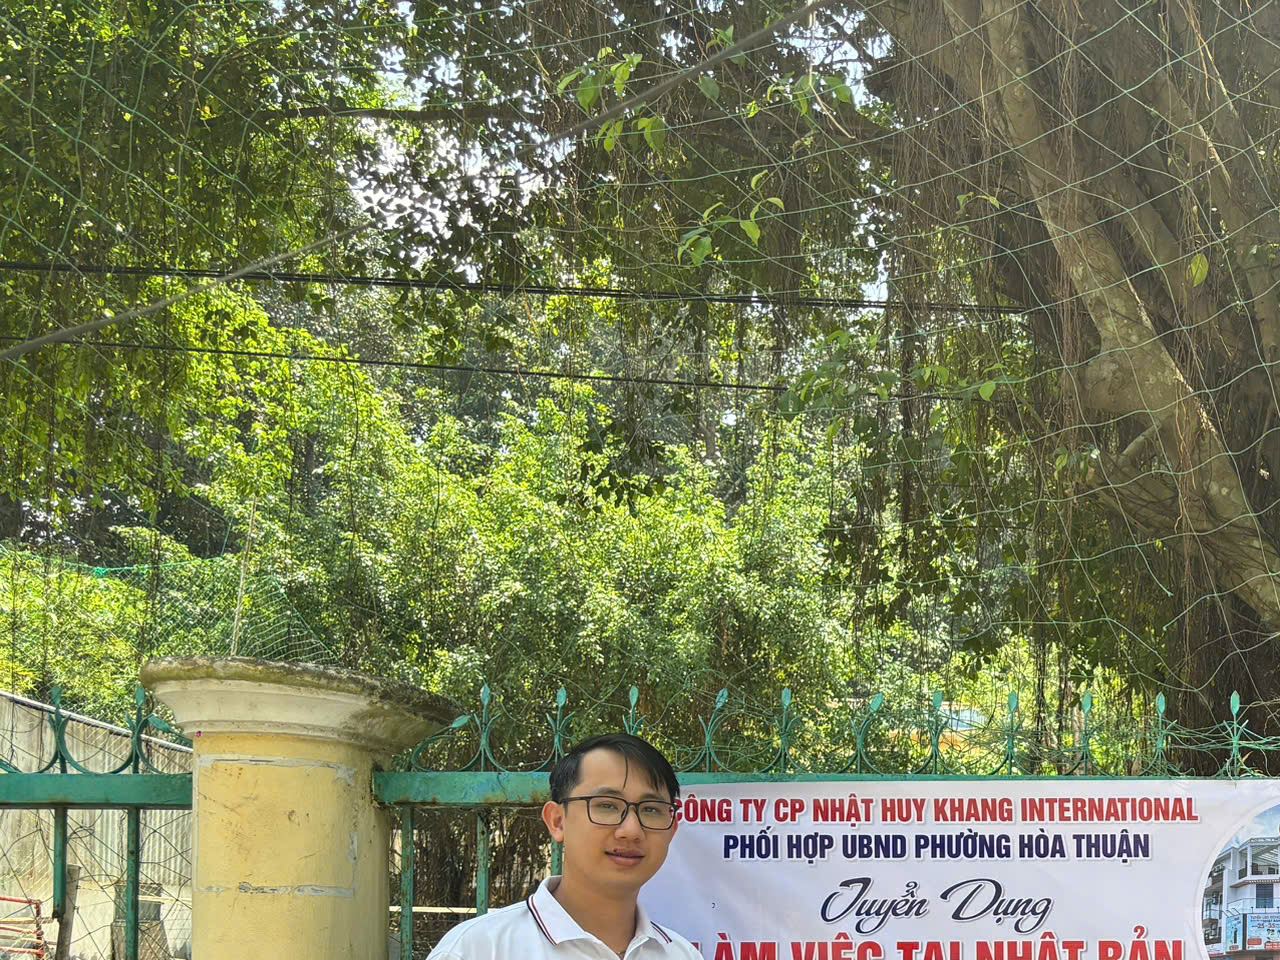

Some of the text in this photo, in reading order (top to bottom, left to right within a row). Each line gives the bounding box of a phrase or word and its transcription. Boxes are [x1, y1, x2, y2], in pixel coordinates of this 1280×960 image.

[675, 793, 1198, 827] CÔNG TY CP NHẬT HUY KHANG INTERNATIONAL
[724, 826, 1149, 863] PHỐI HỢP UBND PHƯỜNG HÒA THUẬN
[820, 877, 1053, 933] Tuyển Dụng
